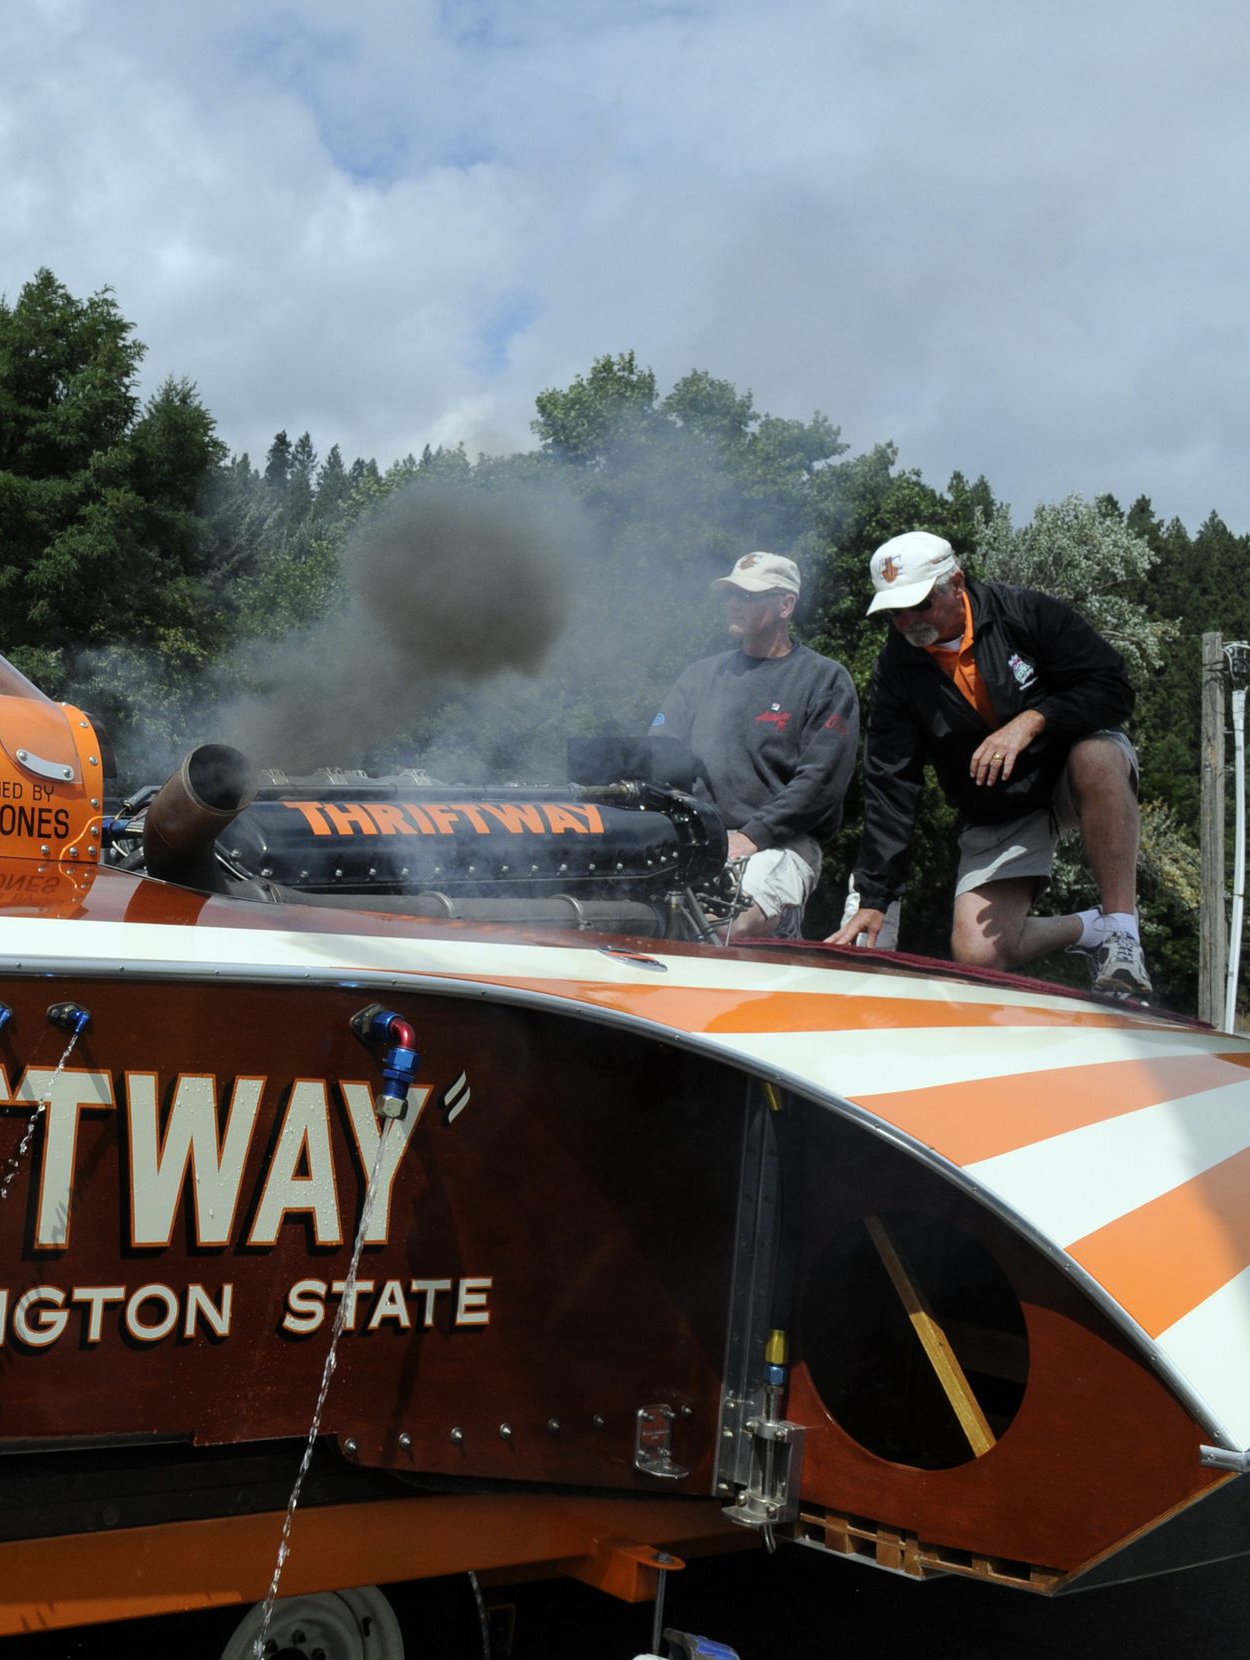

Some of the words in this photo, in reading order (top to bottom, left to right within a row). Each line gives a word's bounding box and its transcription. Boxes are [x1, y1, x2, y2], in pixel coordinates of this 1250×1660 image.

[32, 784, 55, 803] BY
[280, 800, 605, 836] THRIFTWAY
[281, 1275, 494, 1336] STATE
